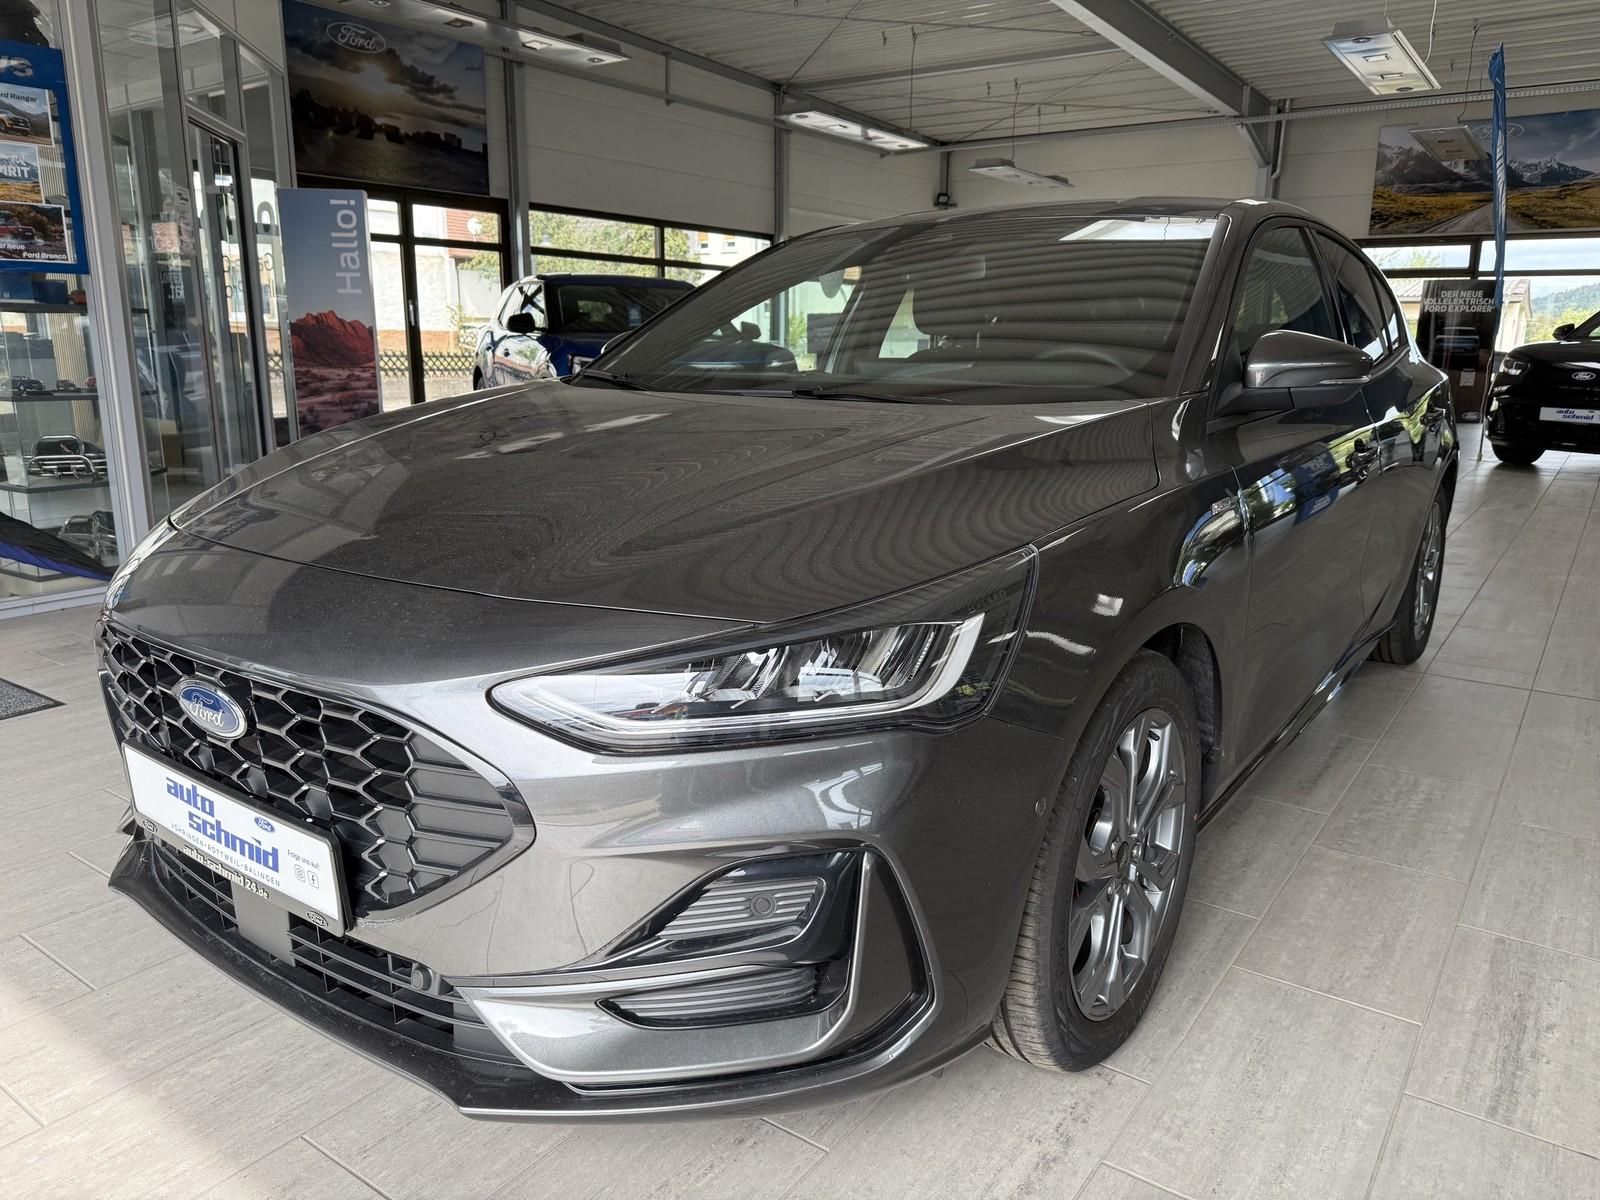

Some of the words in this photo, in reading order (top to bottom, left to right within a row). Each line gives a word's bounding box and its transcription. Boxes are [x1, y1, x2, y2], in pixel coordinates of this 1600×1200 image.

[337, 25, 376, 50] Ford
[10, 92, 38, 102] Ranger
[23, 251, 40, 259] Ford
[41, 252, 67, 260] Bronco
[330, 198, 362, 295] Hallo!
[1441, 290, 1459, 298] DER
[1460, 290, 1484, 298] NEUE
[1424, 304, 1447, 313] FORD
[190, 691, 225, 727] Ford
[166, 777, 215, 818] auto
[188, 811, 280, 873] schmid
[287, 849, 300, 861] Folge
